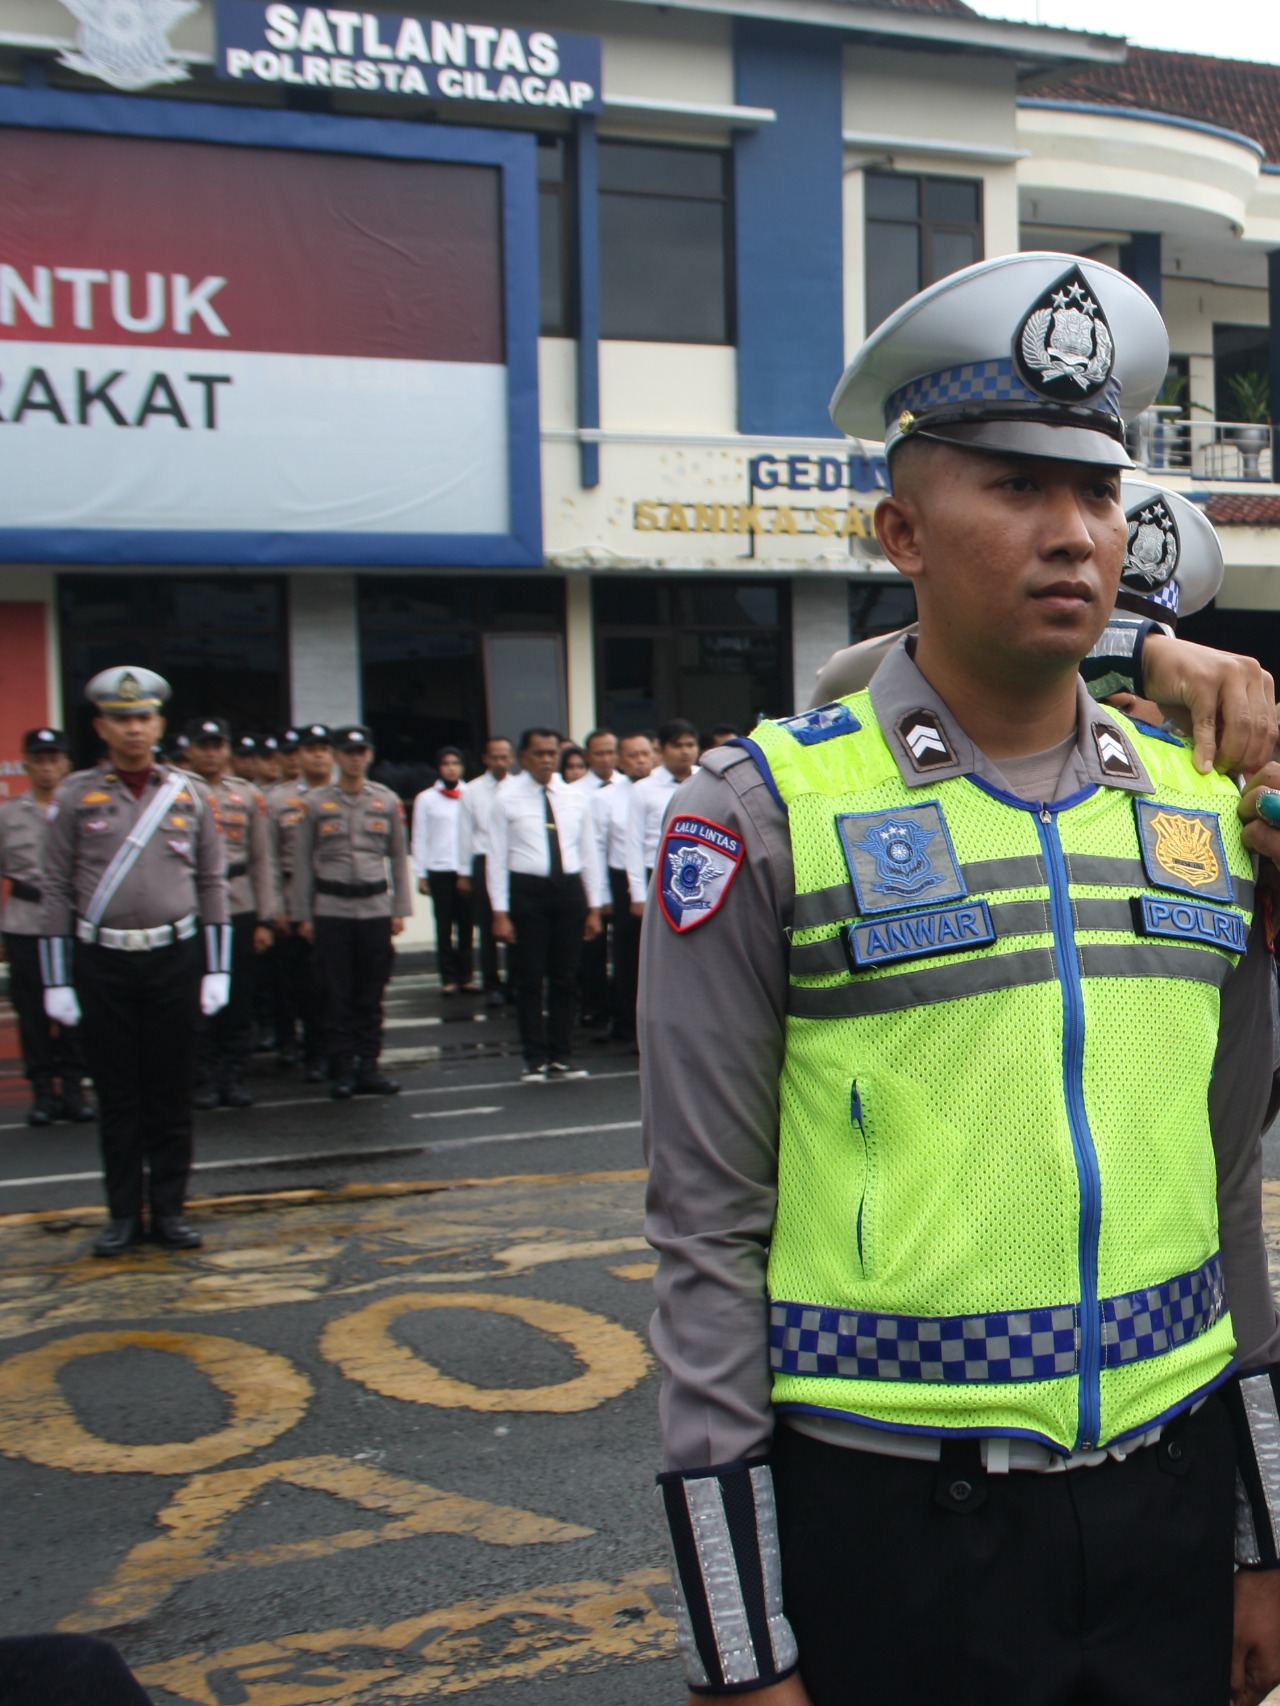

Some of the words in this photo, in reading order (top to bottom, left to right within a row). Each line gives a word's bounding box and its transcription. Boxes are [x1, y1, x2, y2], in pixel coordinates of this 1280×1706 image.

[265, 3, 560, 76] SATLANTAS
[226, 48, 429, 95] POLRESTA
[437, 79, 594, 109] CILACAP
[0, 365, 232, 430] AKAT
[634, 499, 799, 536] SANIKA
[674, 822, 698, 834] LALU
[699, 827, 738, 851] LINTAS
[866, 910, 980, 956] ANWAR
[1150, 903, 1238, 944] POLRI
